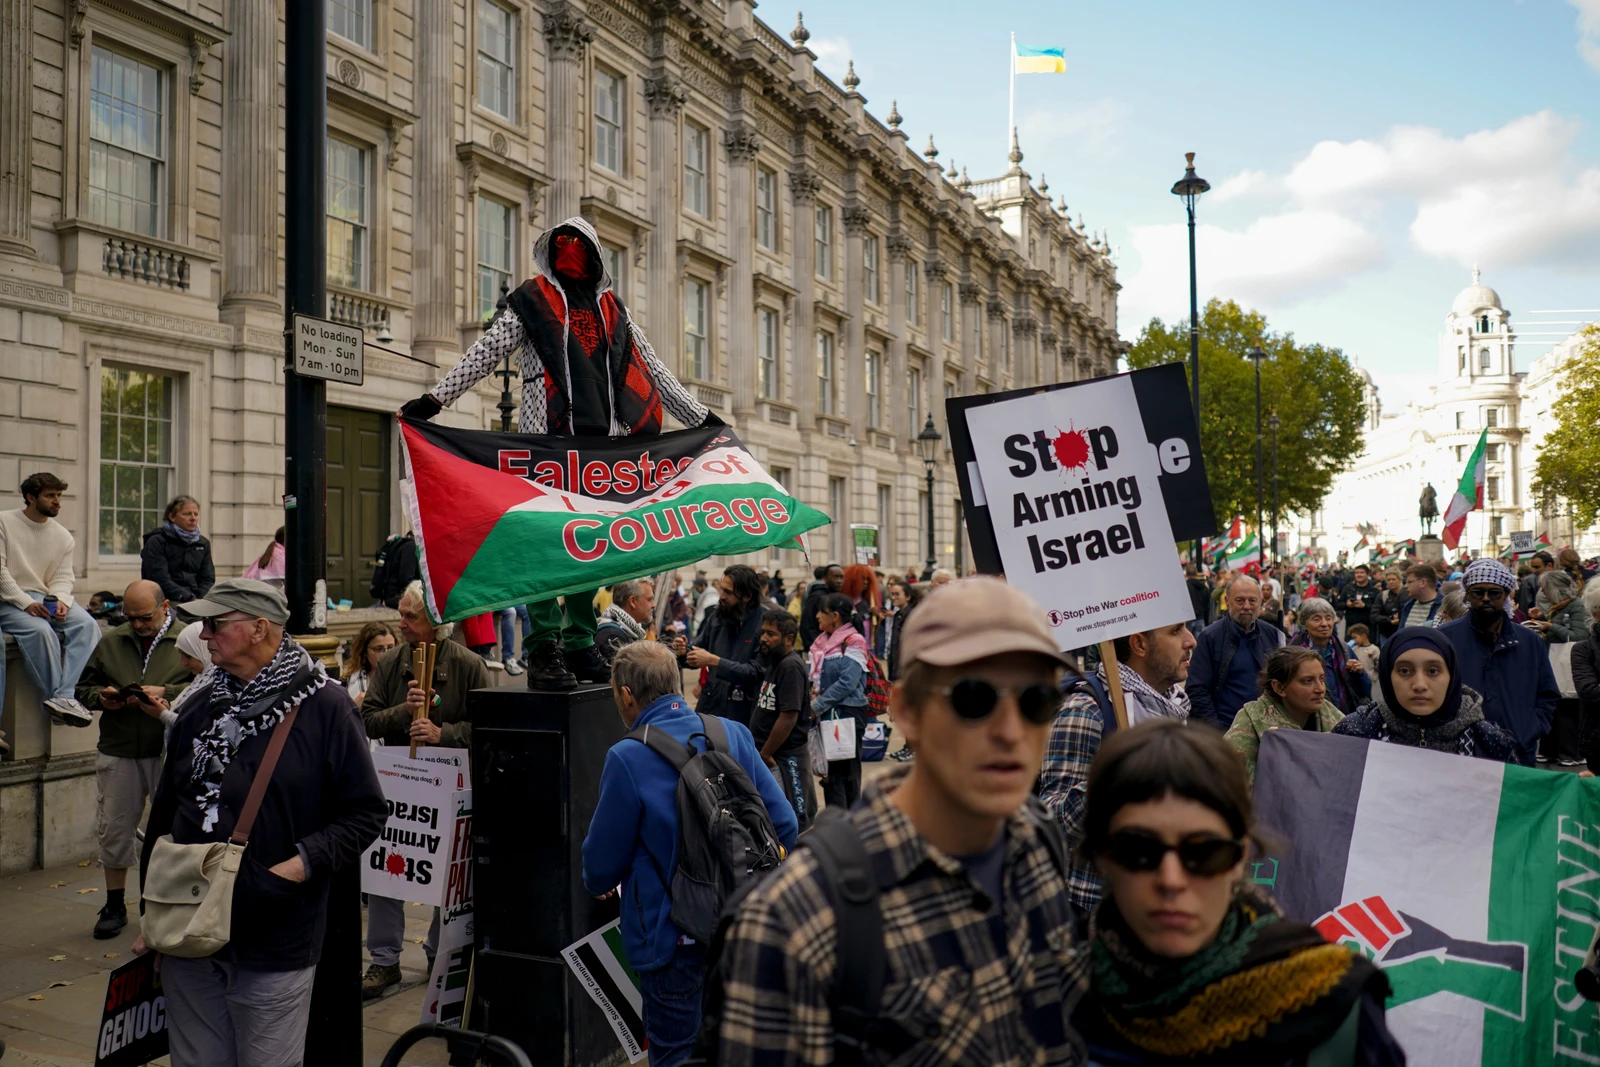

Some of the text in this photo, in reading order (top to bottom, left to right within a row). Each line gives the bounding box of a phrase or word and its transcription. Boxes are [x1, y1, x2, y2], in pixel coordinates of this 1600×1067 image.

[301, 323, 357, 347] No loading
[303, 340, 326, 355] Mon
[335, 347, 356, 360] Sun
[701, 453, 752, 475] of
[1012, 475, 1143, 528] Arming
[562, 494, 791, 562] Courage
[1026, 512, 1146, 574] Israel
[1062, 589, 1160, 621] Stop the War coalition
[1075, 612, 1138, 634] www.stopwar.org.uk
[419, 776, 433, 785] Stop
[385, 798, 439, 830] Isra
[380, 826, 441, 855] Armin
[106, 966, 147, 1012] STOP
[568, 951, 640, 1057] Palestine Solidarity Campaign
[98, 995, 169, 1060] GENOC
